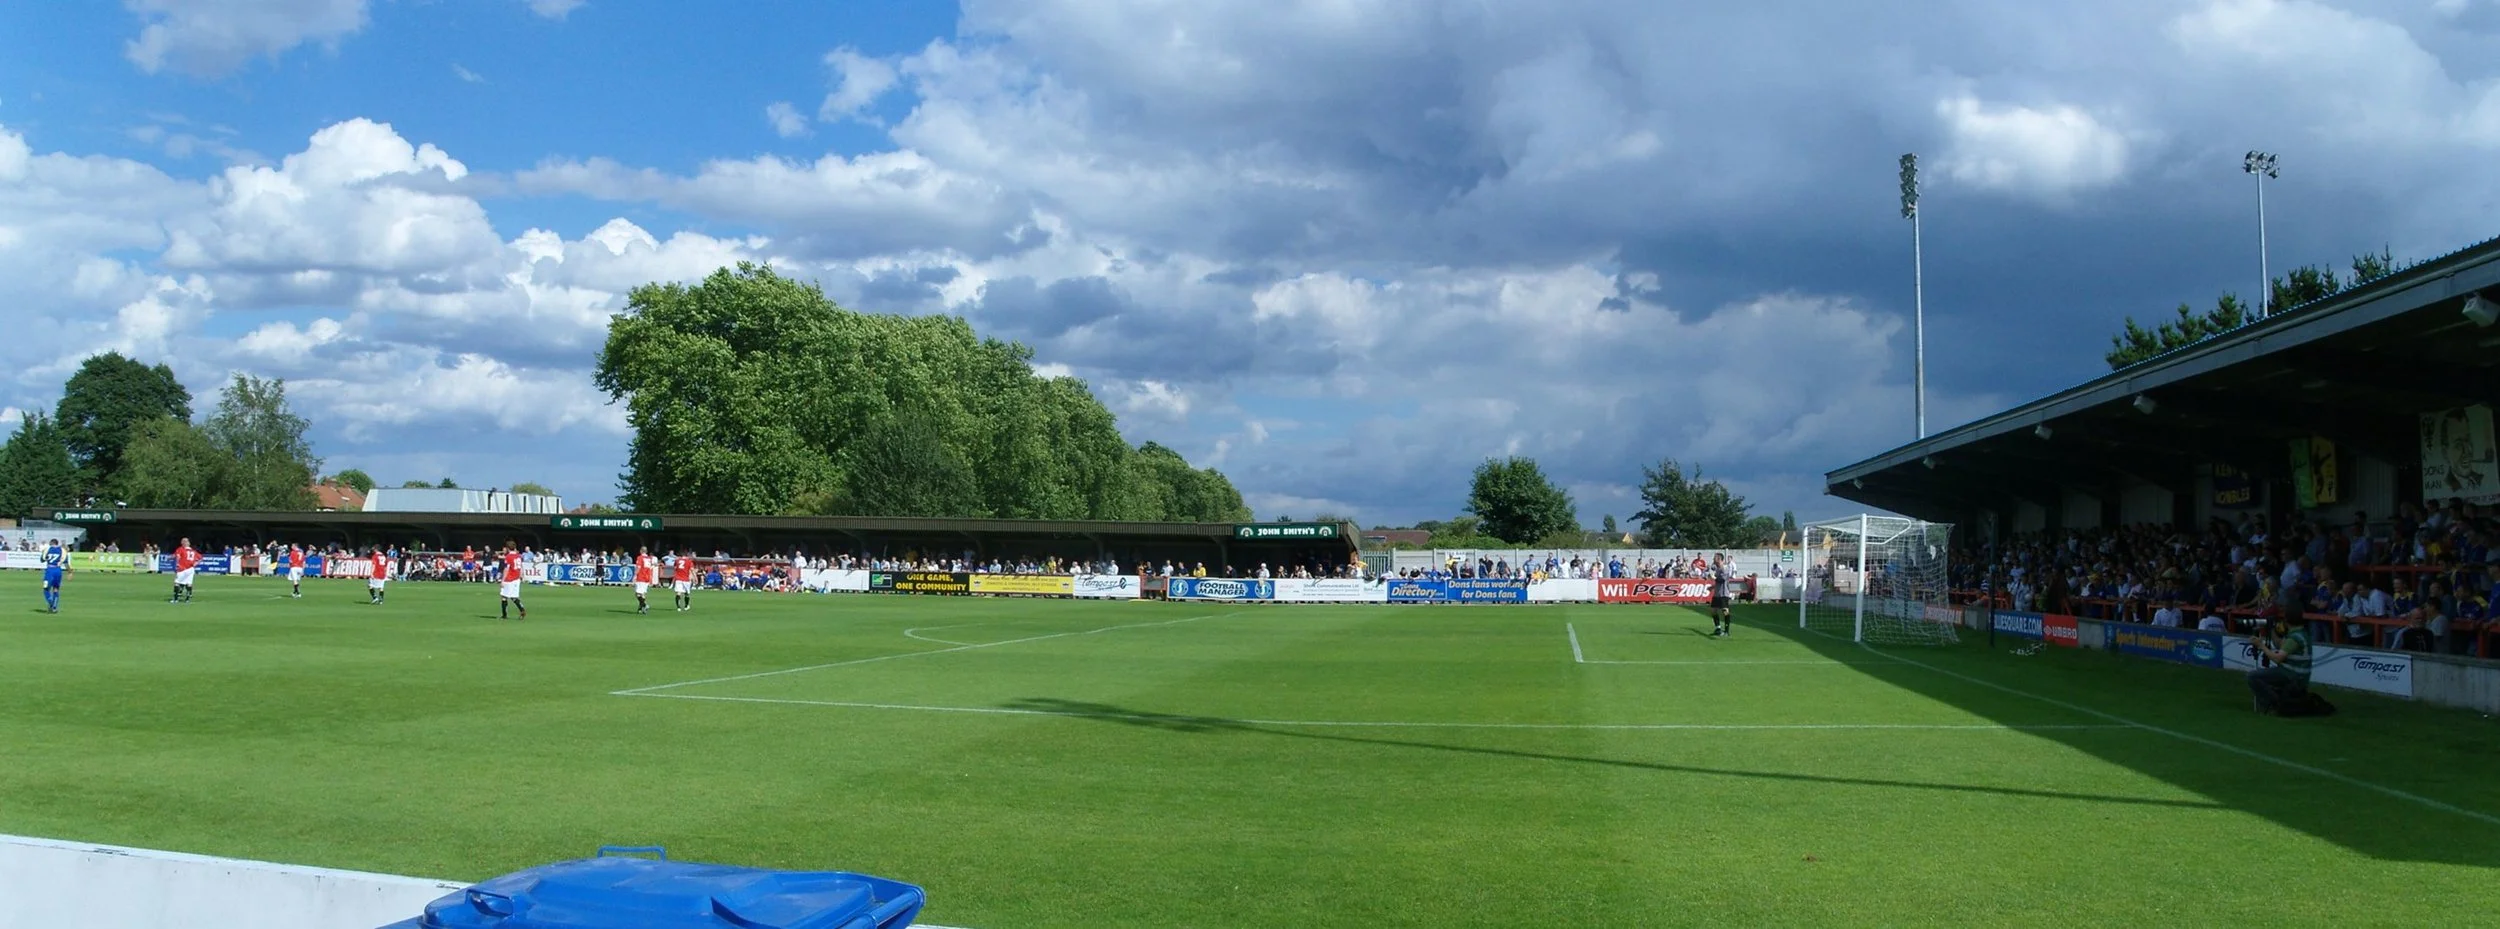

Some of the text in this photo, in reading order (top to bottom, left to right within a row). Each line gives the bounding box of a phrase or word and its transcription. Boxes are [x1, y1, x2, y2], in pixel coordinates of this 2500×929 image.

[579, 518, 633, 527] JOHN SMITH'S
[1257, 527, 1315, 536] JOHN SMITH'S
[678, 560, 685, 569] 2
[906, 573, 925, 581] ONE
[915, 583, 967, 591] COMMUNITY
[1448, 580, 1525, 590] Dons fans working
[1461, 590, 1517, 598] for Dons fans
[1601, 583, 1628, 597] Wii
[1632, 583, 1680, 597] PES
[2052, 626, 2078, 639] UMBRO
